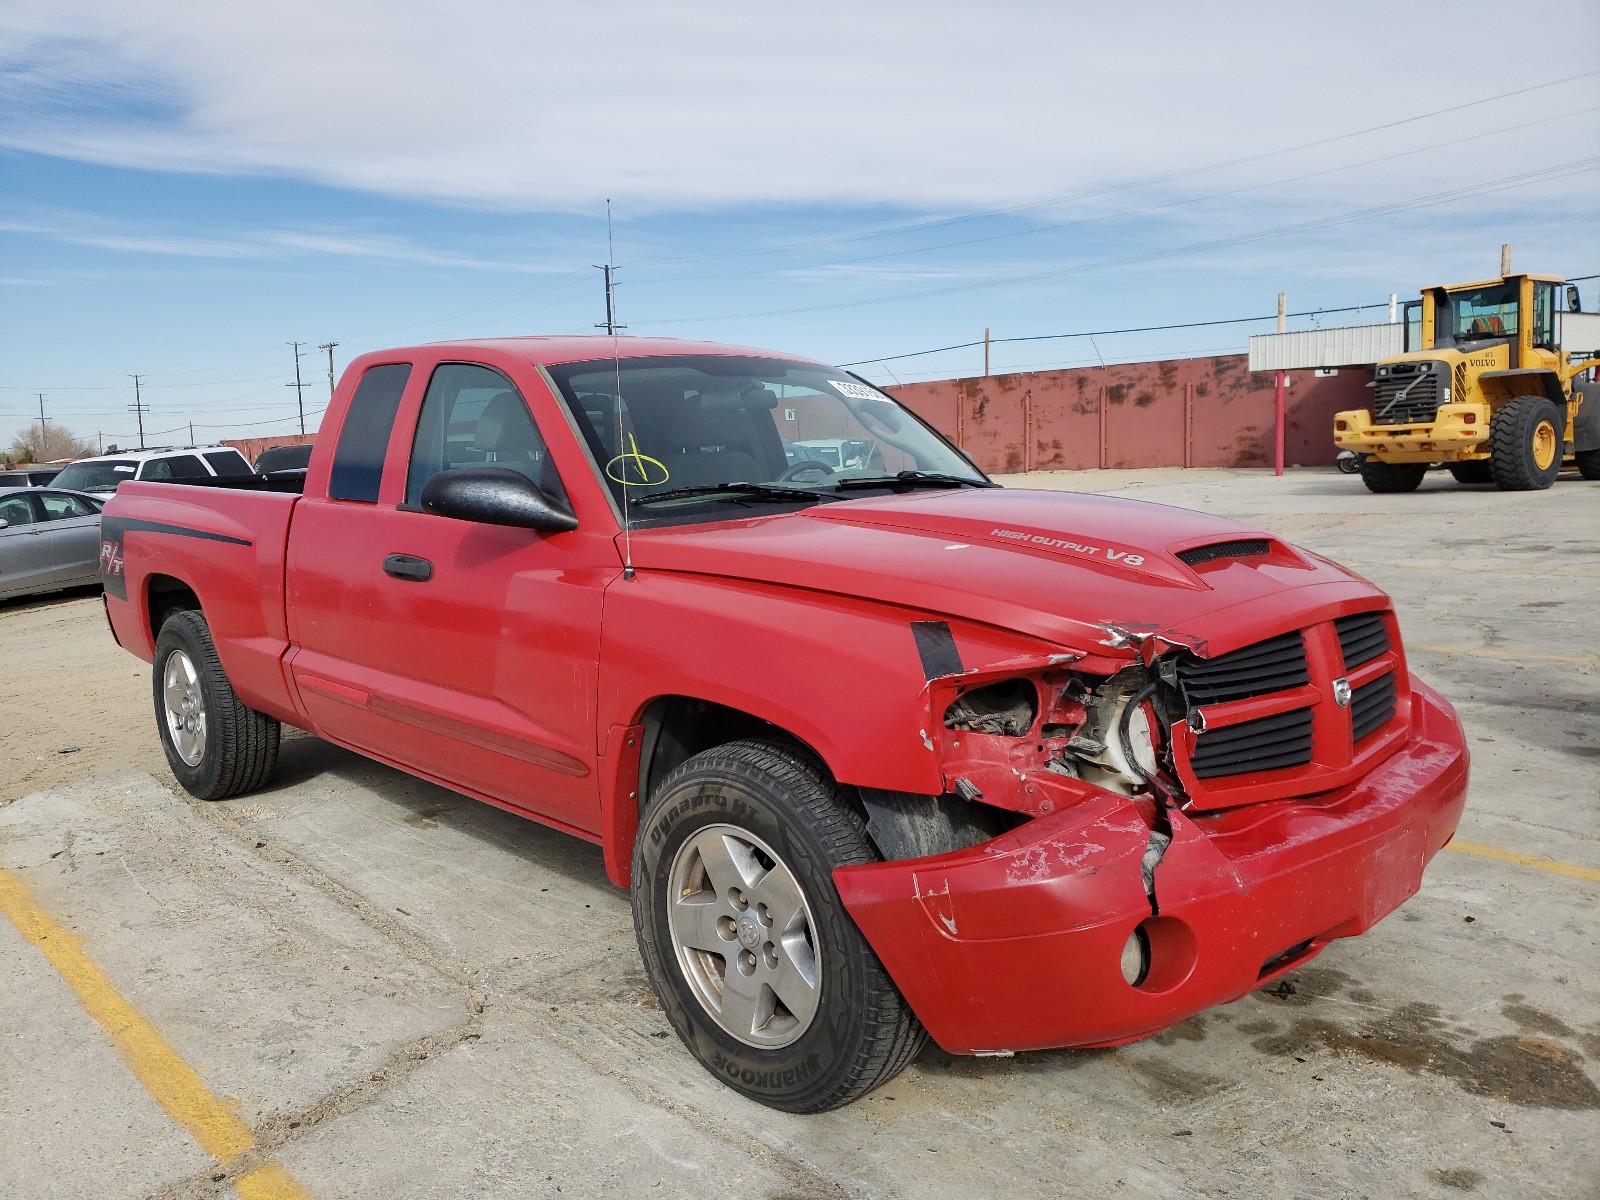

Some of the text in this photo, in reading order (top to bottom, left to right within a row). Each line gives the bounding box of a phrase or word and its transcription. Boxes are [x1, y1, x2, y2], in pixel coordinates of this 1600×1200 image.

[1469, 359, 1496, 367] VOLVO
[101, 541, 124, 575] R/T
[990, 528, 1145, 566] HIGH OUTPUT V8
